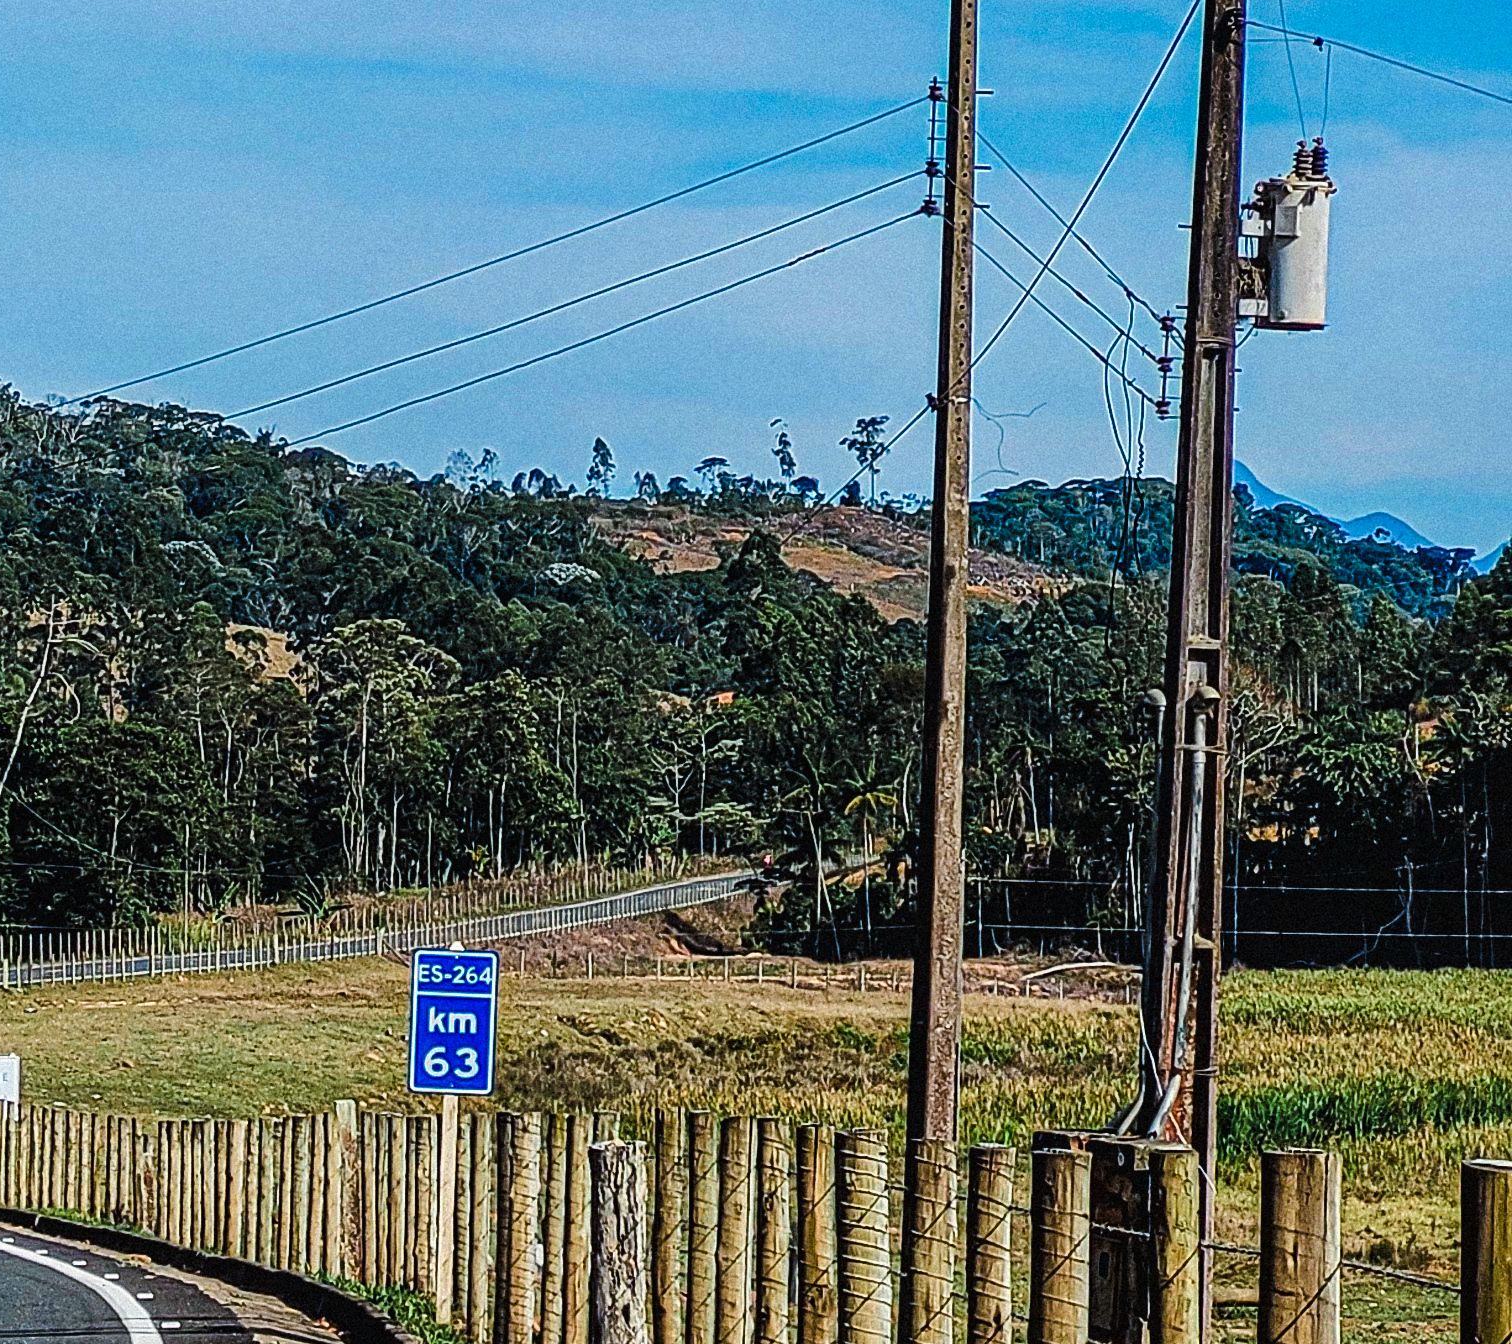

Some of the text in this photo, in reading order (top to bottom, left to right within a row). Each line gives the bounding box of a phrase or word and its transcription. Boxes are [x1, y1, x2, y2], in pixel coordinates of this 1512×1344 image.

[418, 964, 493, 985] ES-264
[428, 1006, 478, 1034] km
[424, 1047, 480, 1078] 63
